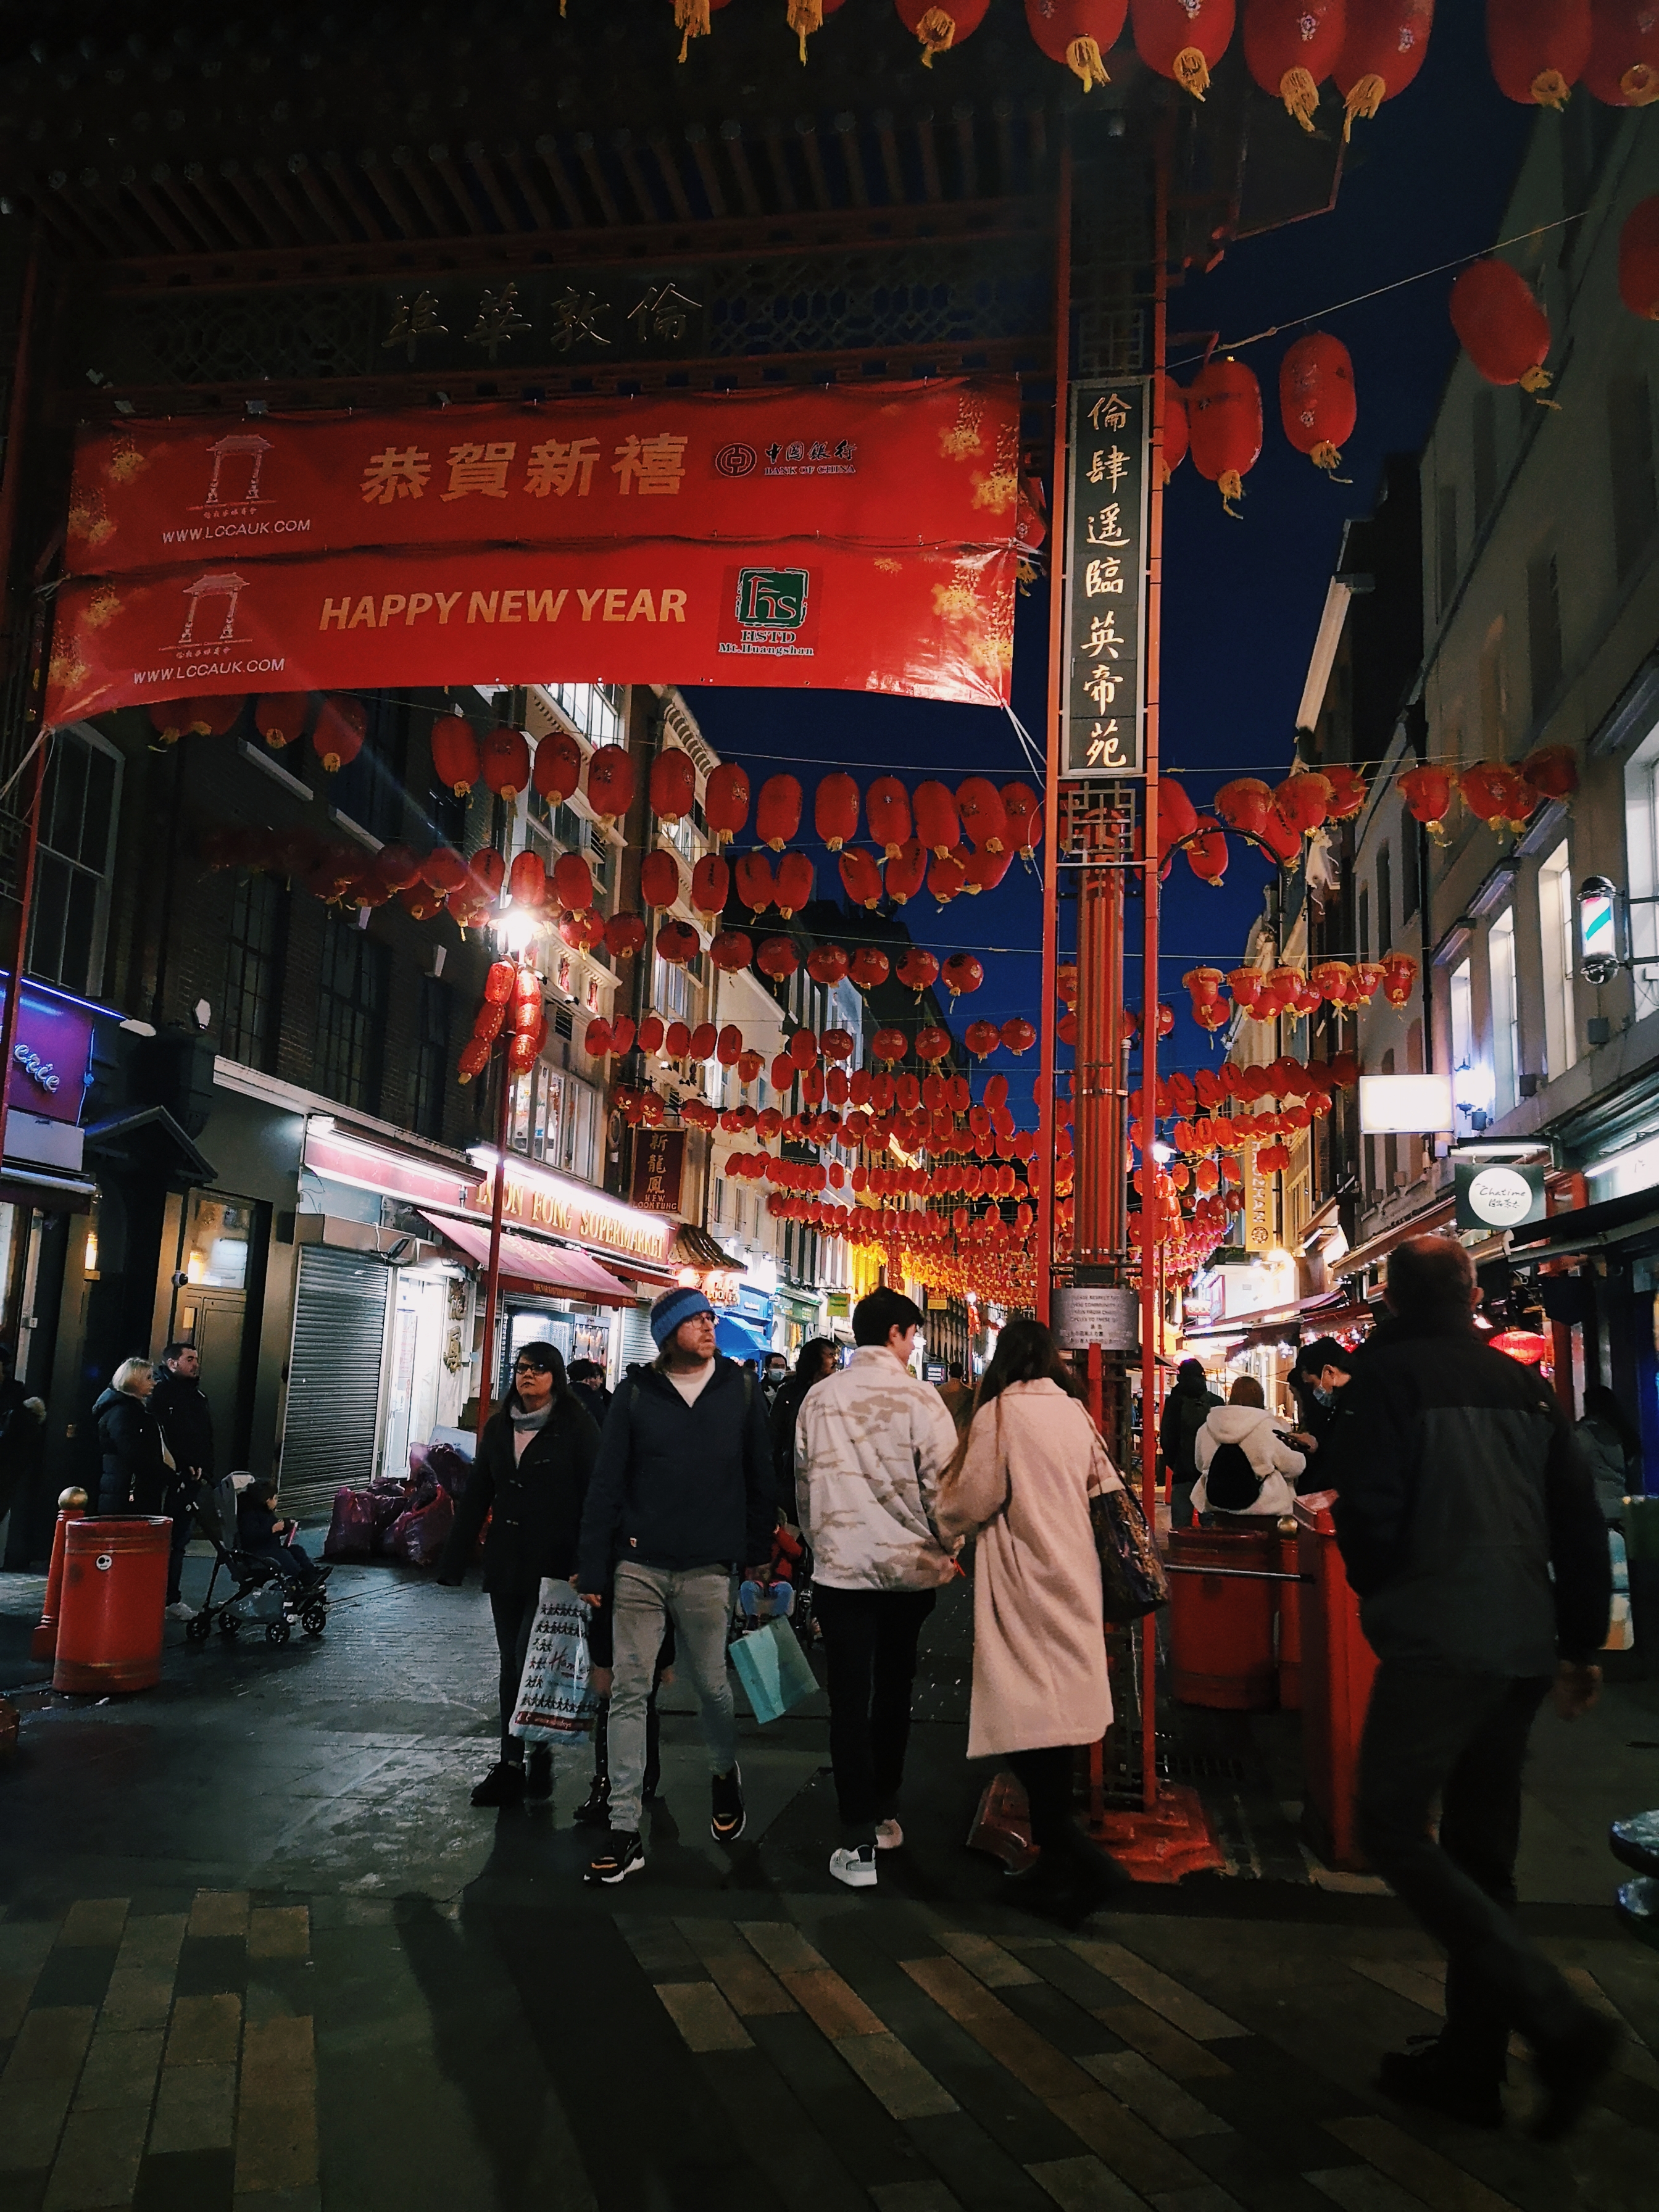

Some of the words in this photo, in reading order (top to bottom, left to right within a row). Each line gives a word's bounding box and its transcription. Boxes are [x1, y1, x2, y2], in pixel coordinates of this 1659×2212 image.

[359, 433, 688, 504] 恭賀新禧
[764, 466, 797, 476] BANK
[799, 467, 814, 475] OF
[817, 465, 856, 475] CHINA
[162, 518, 312, 544] WWW.LCCAUK.COM
[318, 591, 463, 631] HAPPY
[467, 589, 569, 623] NEW
[576, 588, 688, 622] YEAR
[741, 630, 797, 643] HSTD
[133, 658, 285, 684] WWW.LCCAUK.COM
[1479, 1186, 1526, 1197] Chatime
[532, 1189, 573, 1232] FUNG
[580, 1207, 665, 1260] SUPERMARKET
